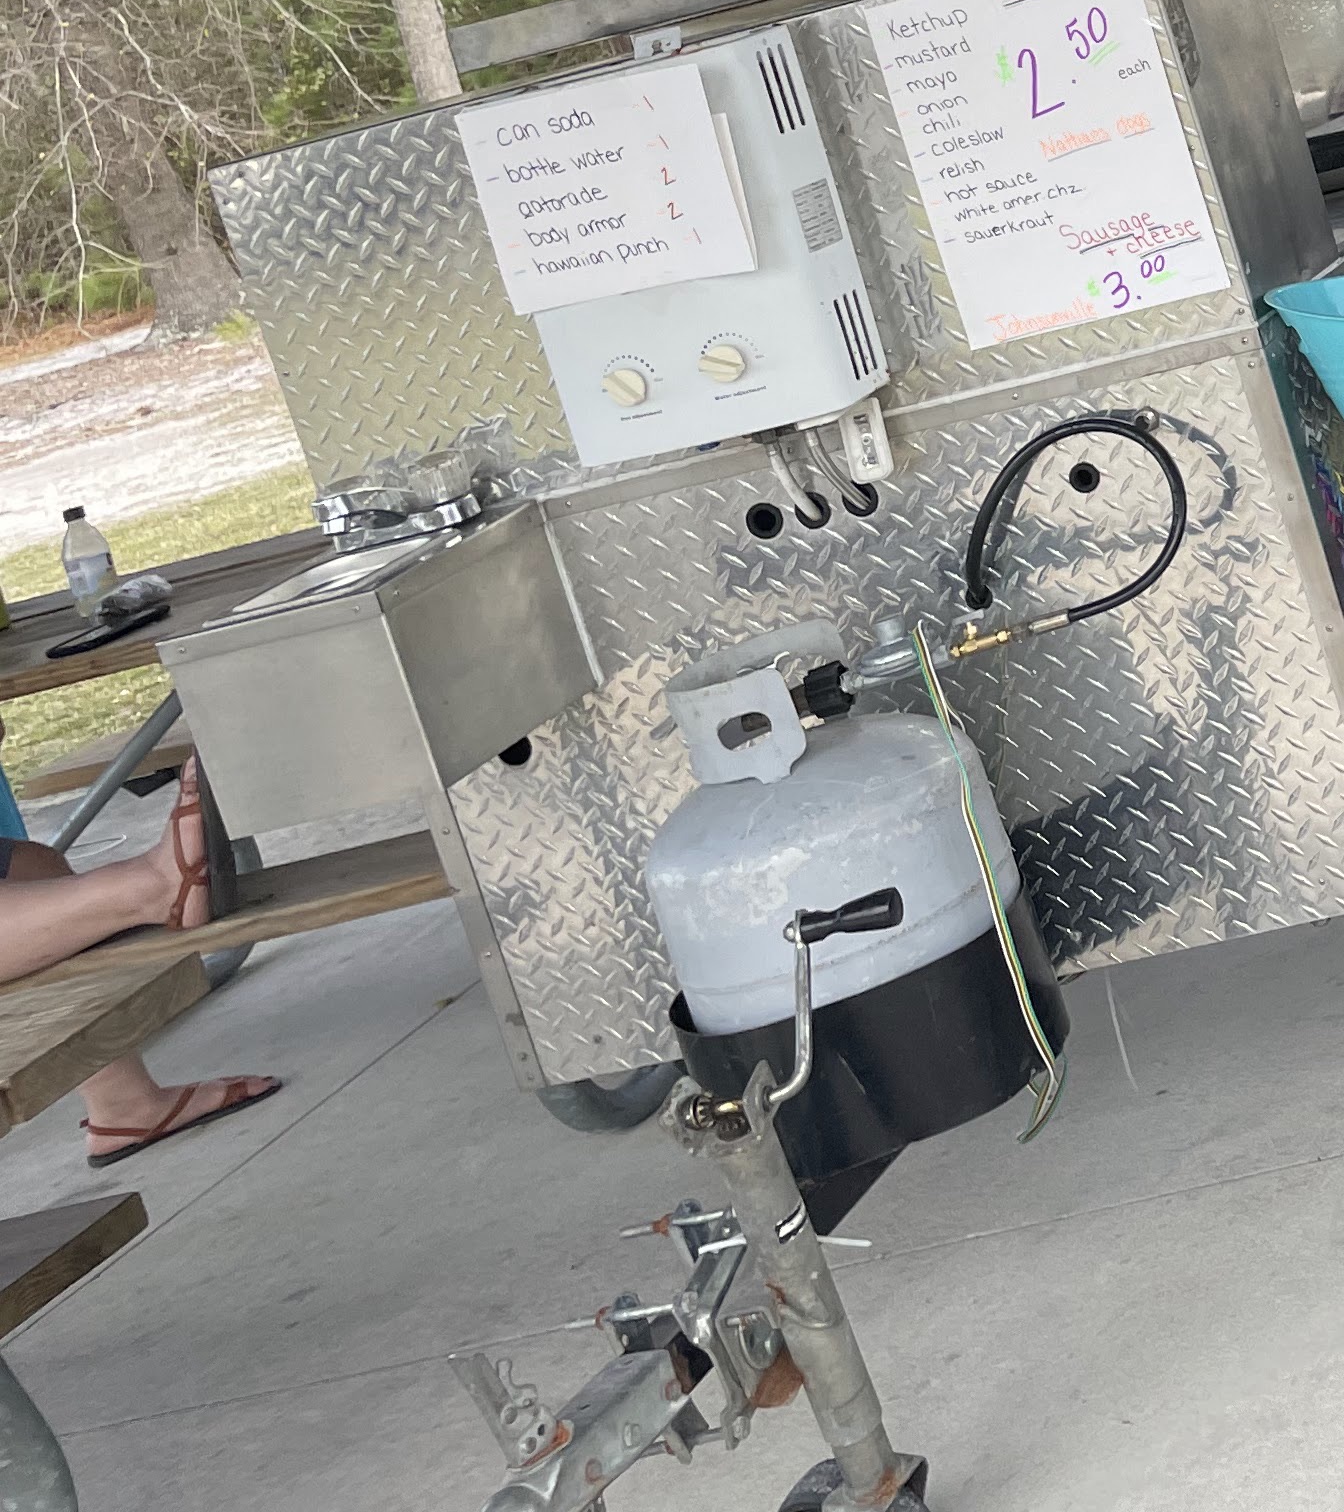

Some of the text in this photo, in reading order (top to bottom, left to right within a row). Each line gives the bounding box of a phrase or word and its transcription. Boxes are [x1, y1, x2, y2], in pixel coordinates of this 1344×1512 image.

[886, 8, 969, 41] Ketchup
[894, 36, 972, 68] mustard
[906, 70, 957, 93] mayo
[1117, 58, 1152, 80] each
[917, 93, 969, 116] onion
[496, 122, 541, 147] can
[547, 108, 596, 136] soda
[922, 113, 961, 136] chili
[931, 126, 1005, 158] coleslaw
[504, 156, 566, 184] bottle
[572, 145, 625, 170] water
[938, 157, 985, 181] relish
[985, 169, 1038, 194] sauce
[517, 185, 609, 220] gatorade
[954, 200, 999, 224] white
[523, 224, 570, 248] body
[577, 212, 628, 238] armor
[1057, 209, 1156, 251] Sausage
[1126, 217, 1202, 255] cheese
[532, 249, 615, 277] hawaiian
[617, 237, 670, 264] punch
